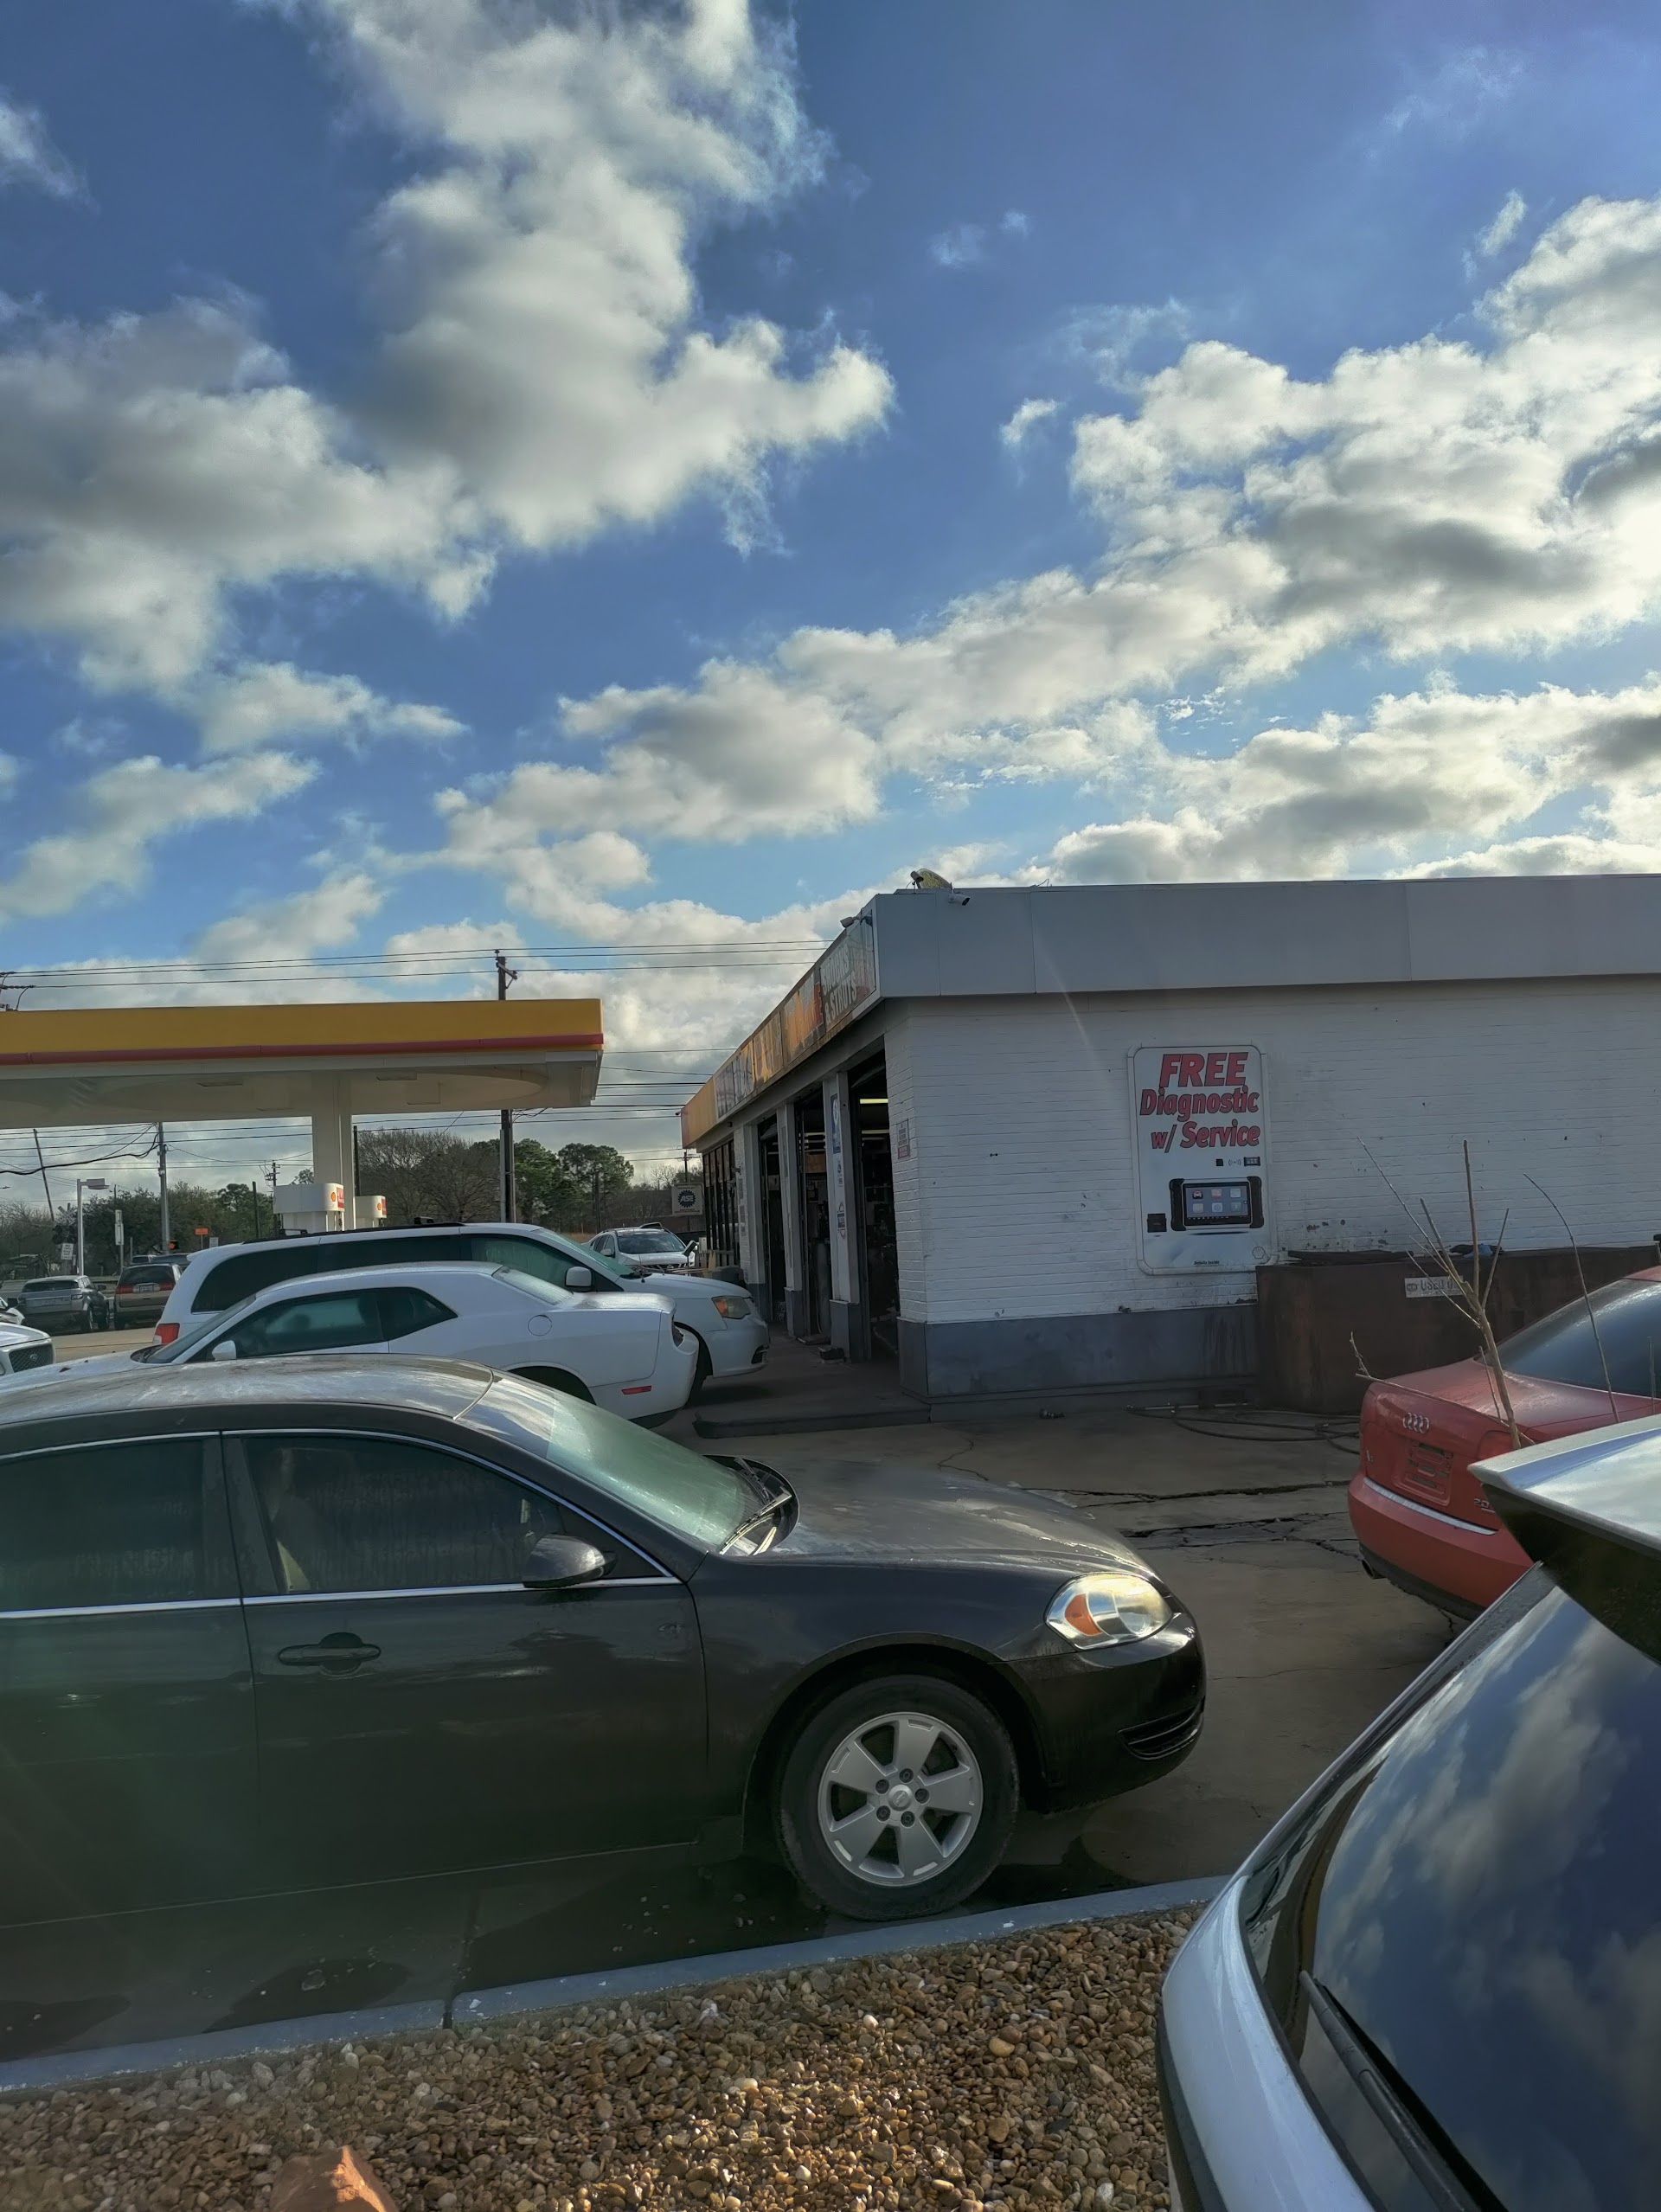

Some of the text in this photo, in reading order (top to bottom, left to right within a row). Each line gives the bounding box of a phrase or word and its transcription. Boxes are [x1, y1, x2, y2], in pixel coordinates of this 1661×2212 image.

[830, 973, 857, 1021] STRUTS
[1159, 1052, 1248, 1087] FREE
[1139, 1085, 1260, 1122] Diagnostic
[1151, 1119, 1260, 1153] w/ Service
